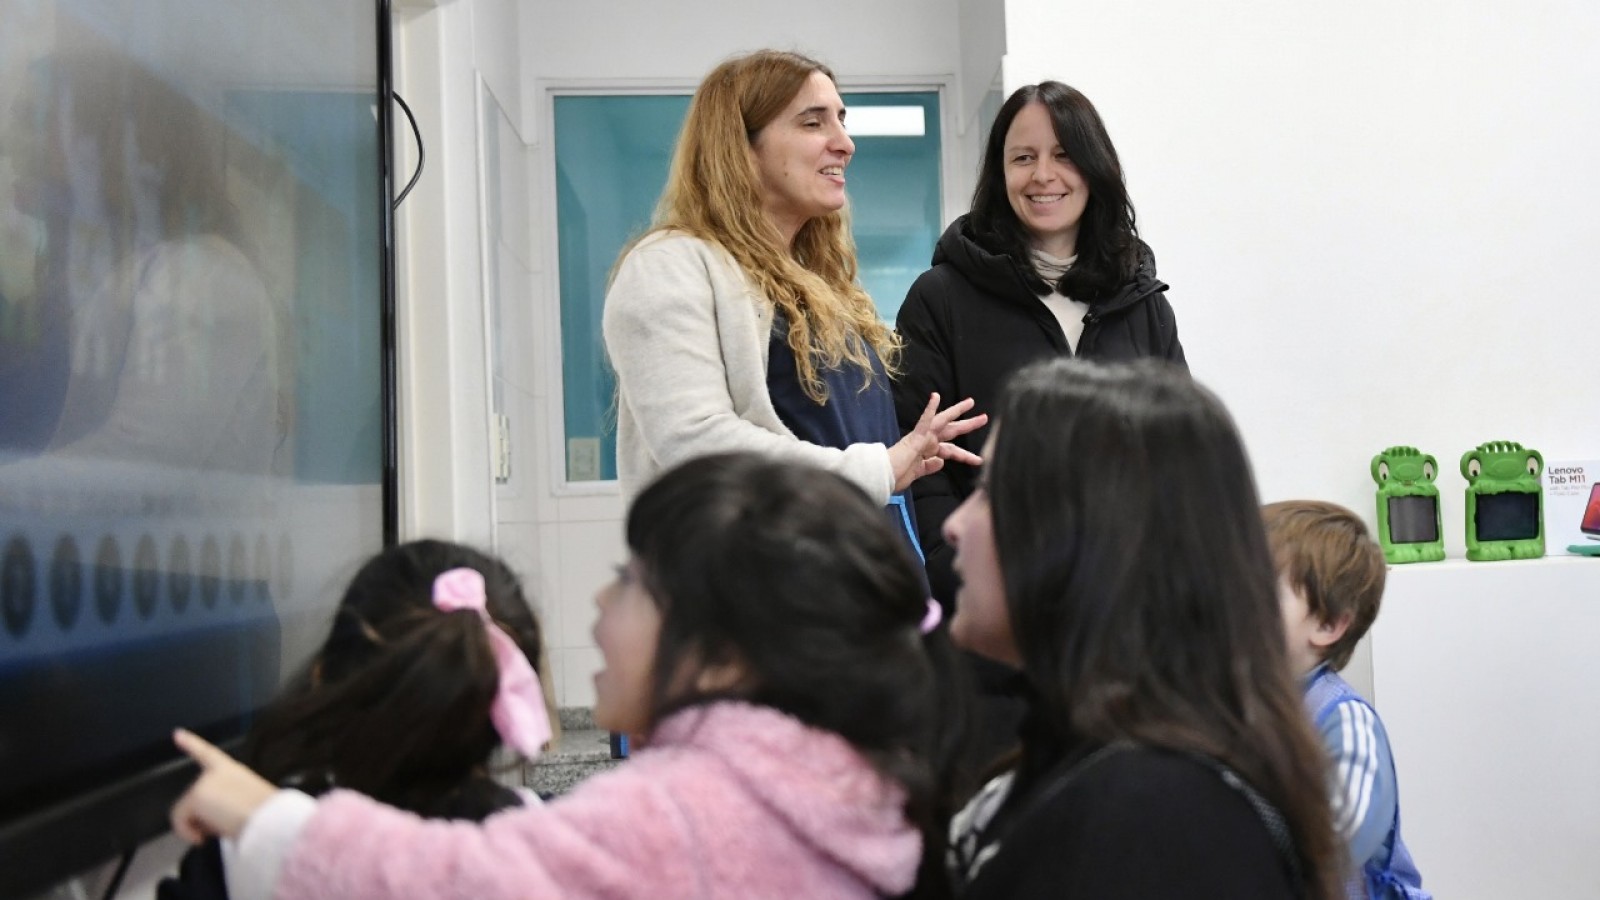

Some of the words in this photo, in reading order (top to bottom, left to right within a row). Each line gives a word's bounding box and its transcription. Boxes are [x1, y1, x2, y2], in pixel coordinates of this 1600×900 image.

[1548, 466, 1584, 475] Lenovo
[1549, 475, 1567, 484] Tab
[1569, 475, 1585, 483] M11
